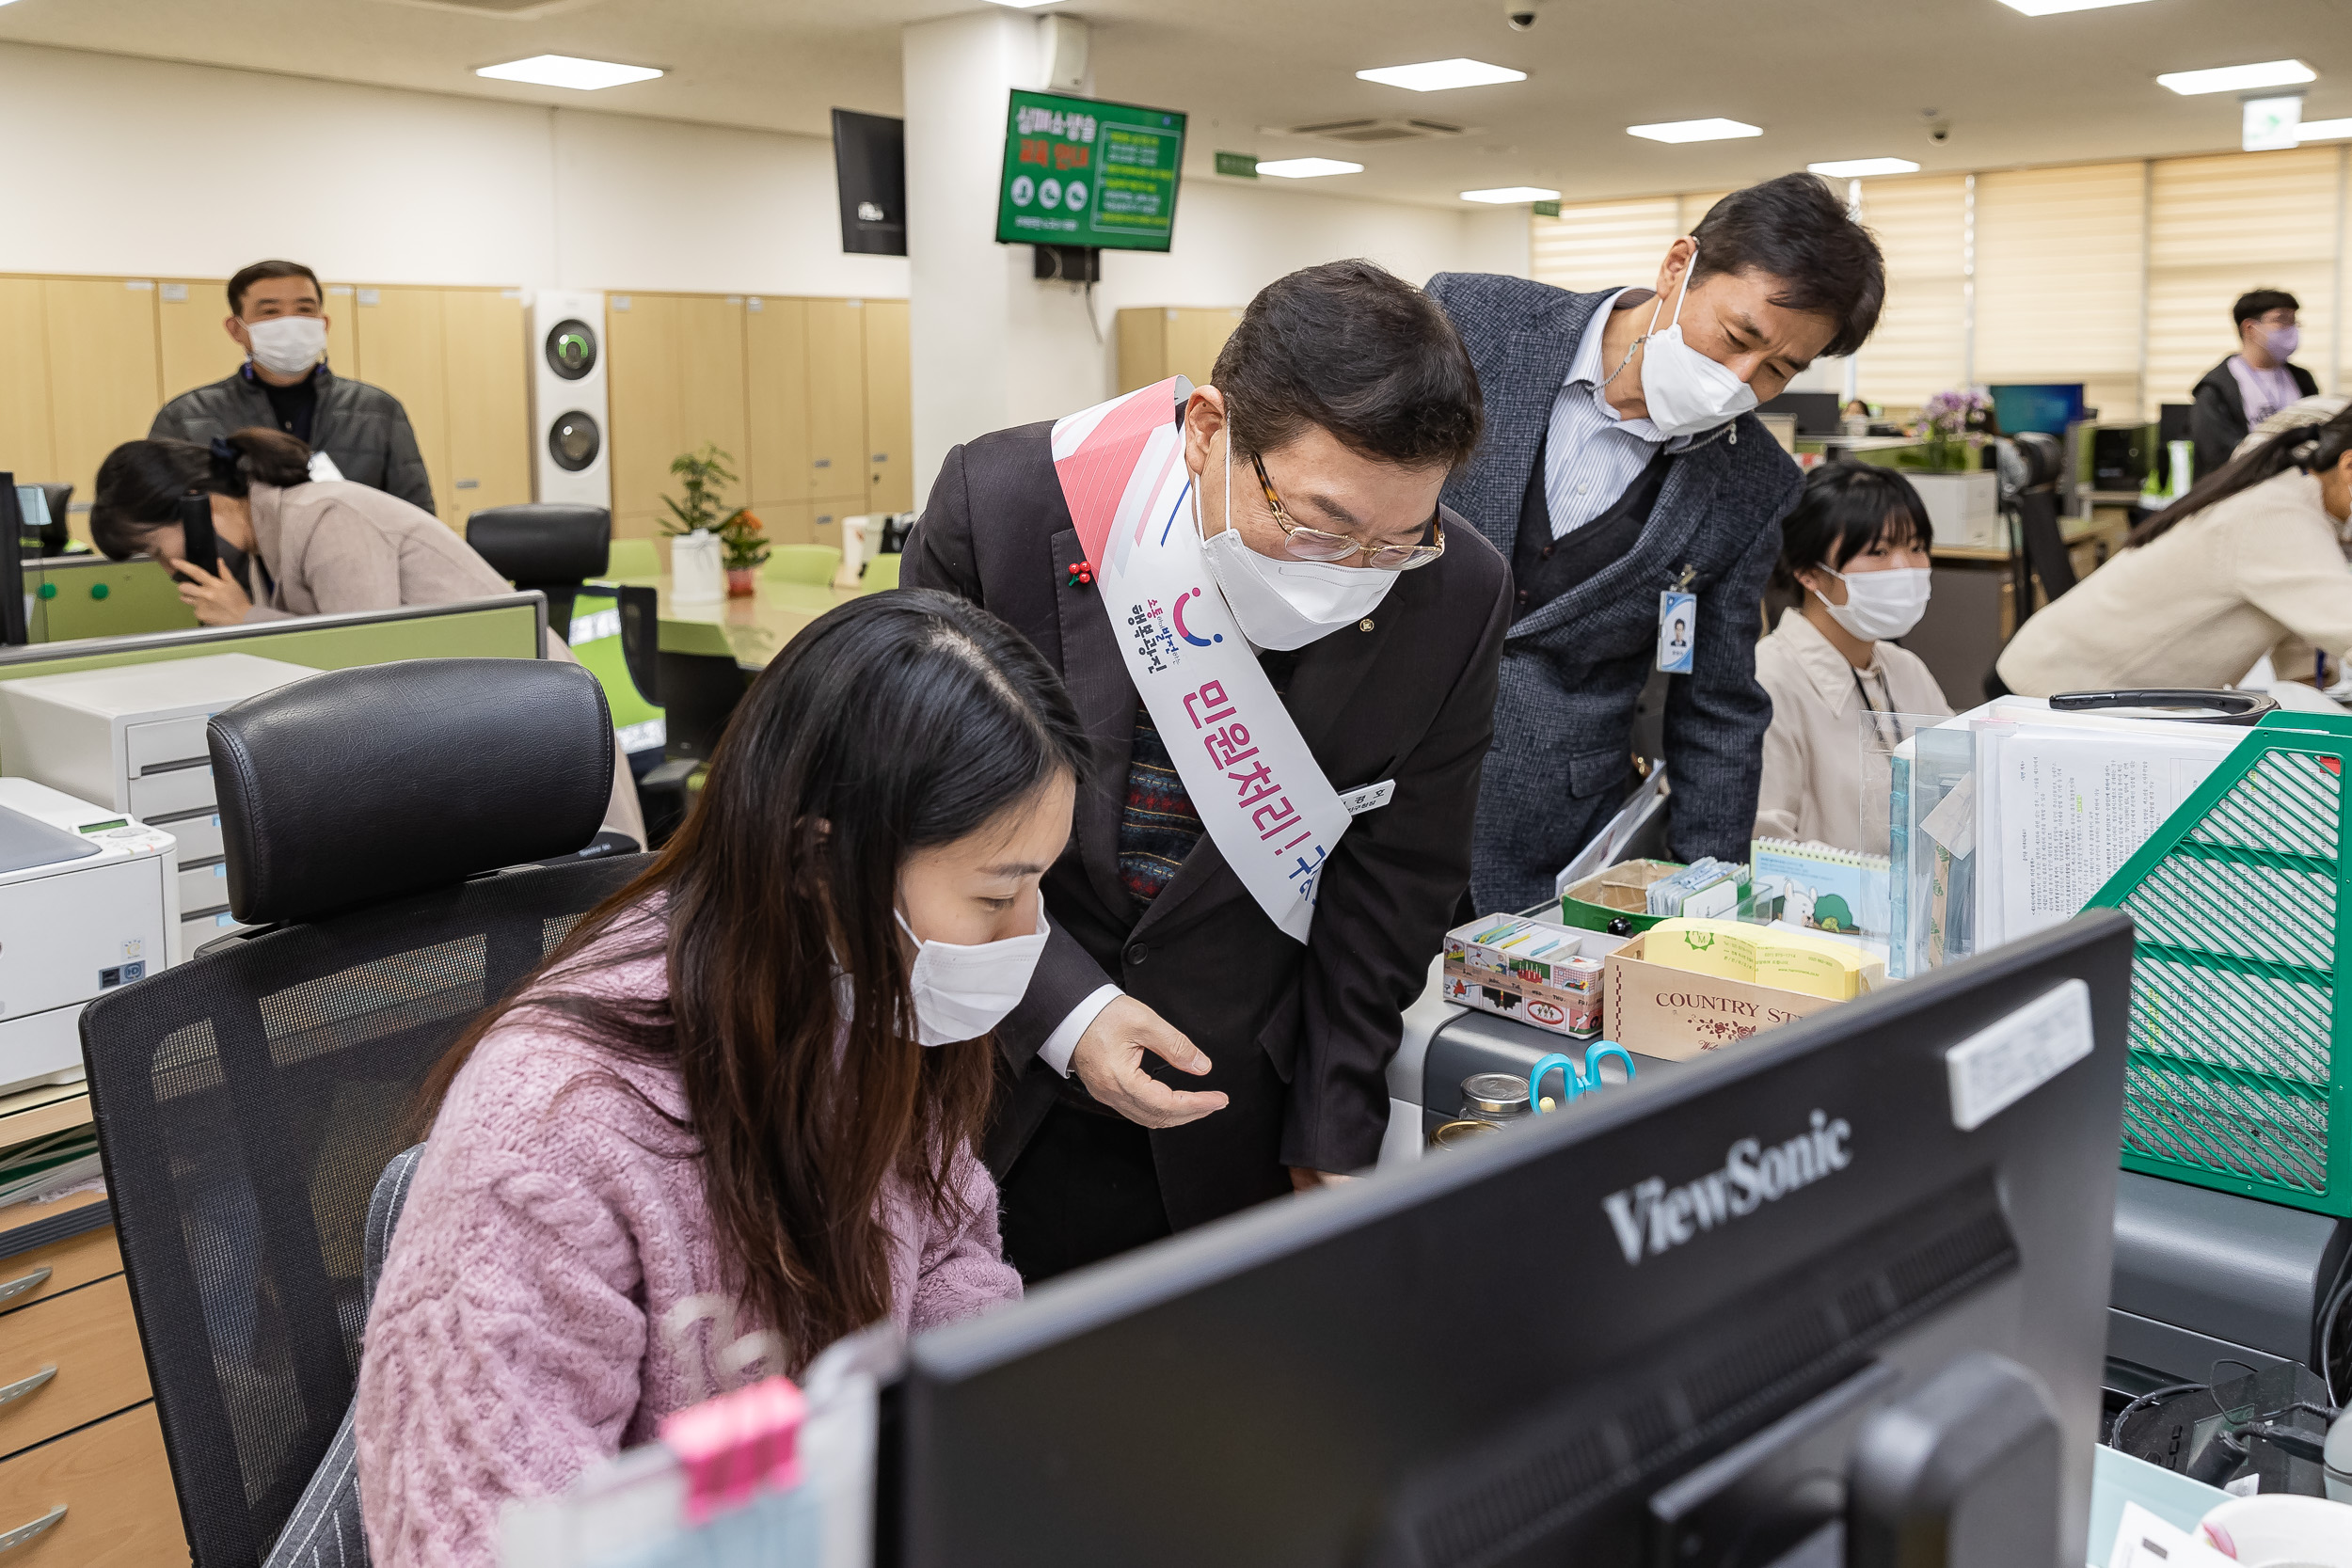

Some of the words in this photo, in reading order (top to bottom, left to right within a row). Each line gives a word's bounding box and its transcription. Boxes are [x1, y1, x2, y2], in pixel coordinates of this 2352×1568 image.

[1128, 605, 1168, 674] 행복광진
[1656, 992, 1759, 1017] COUNTRY
[1601, 1108, 1853, 1266] ViewSonic
